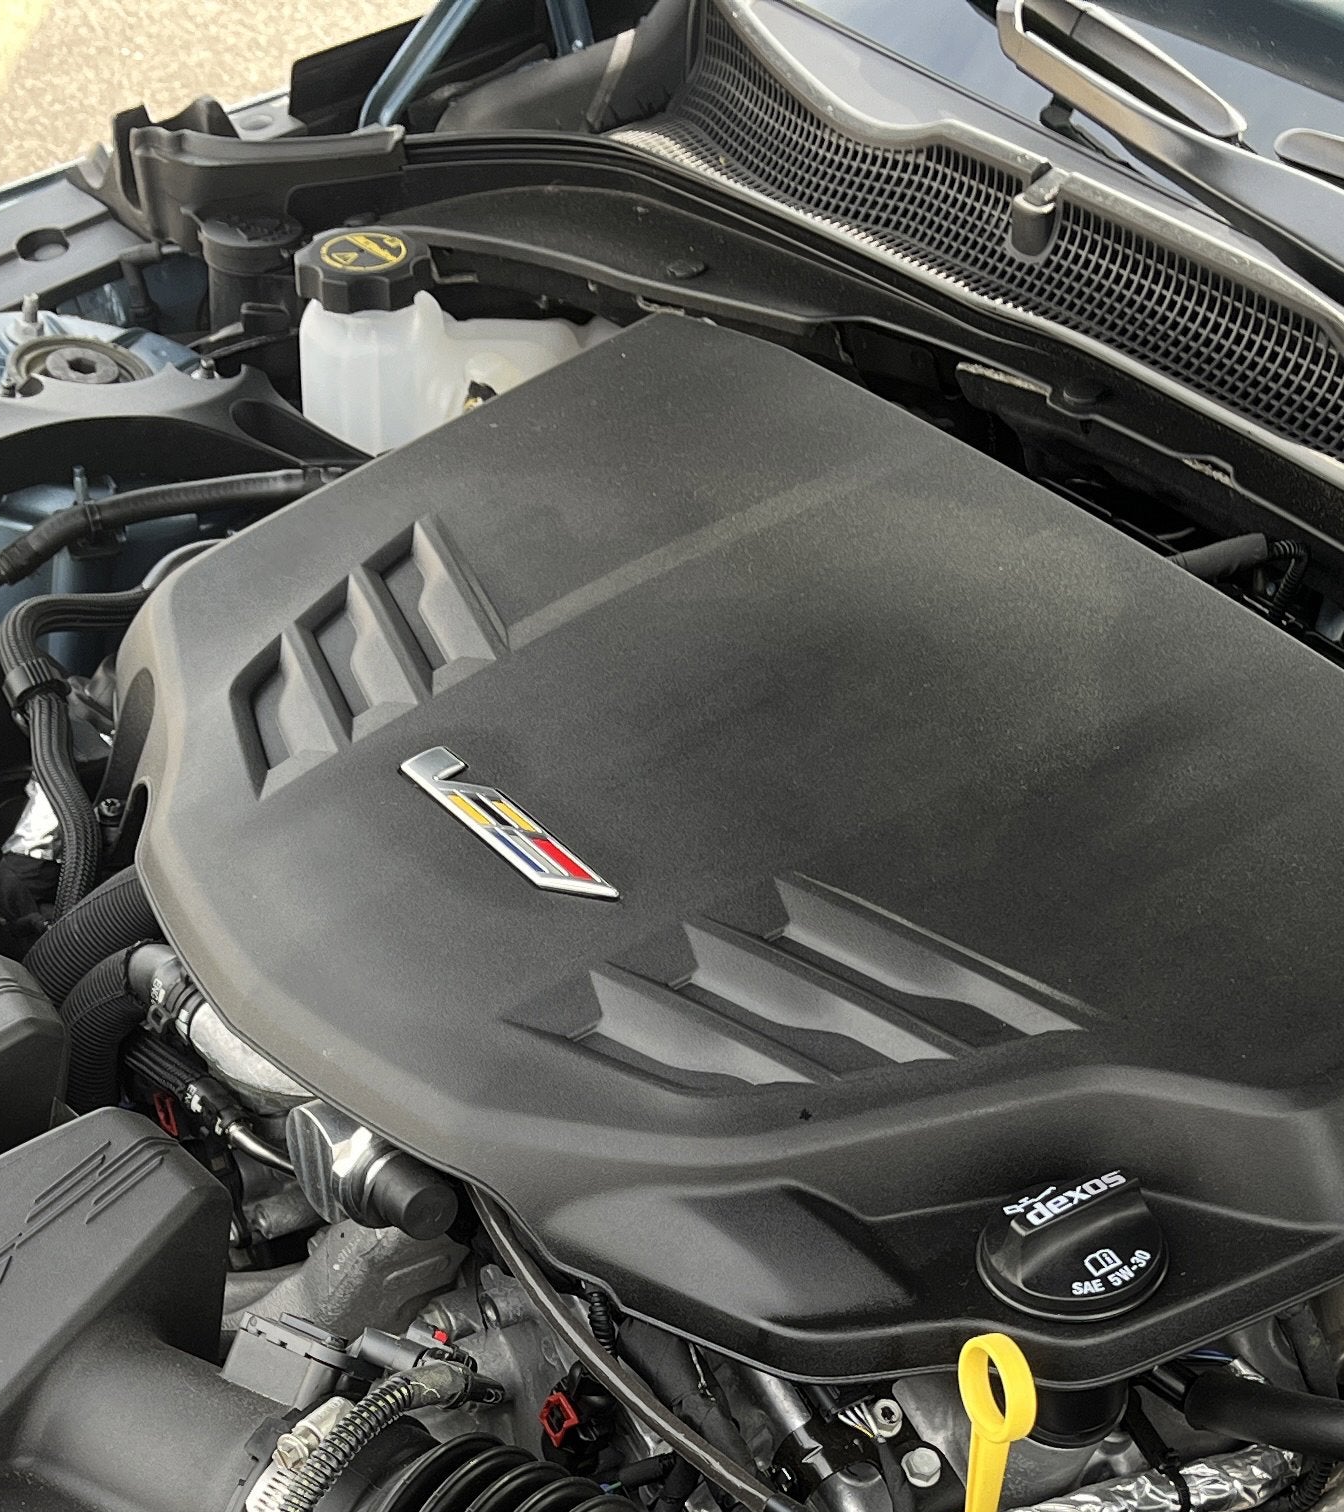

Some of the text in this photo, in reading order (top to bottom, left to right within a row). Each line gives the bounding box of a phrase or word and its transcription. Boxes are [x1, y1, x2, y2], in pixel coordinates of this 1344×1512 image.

[1026, 1169, 1127, 1226] dexos
[1071, 1249, 1152, 1296] SAE 5W-30
